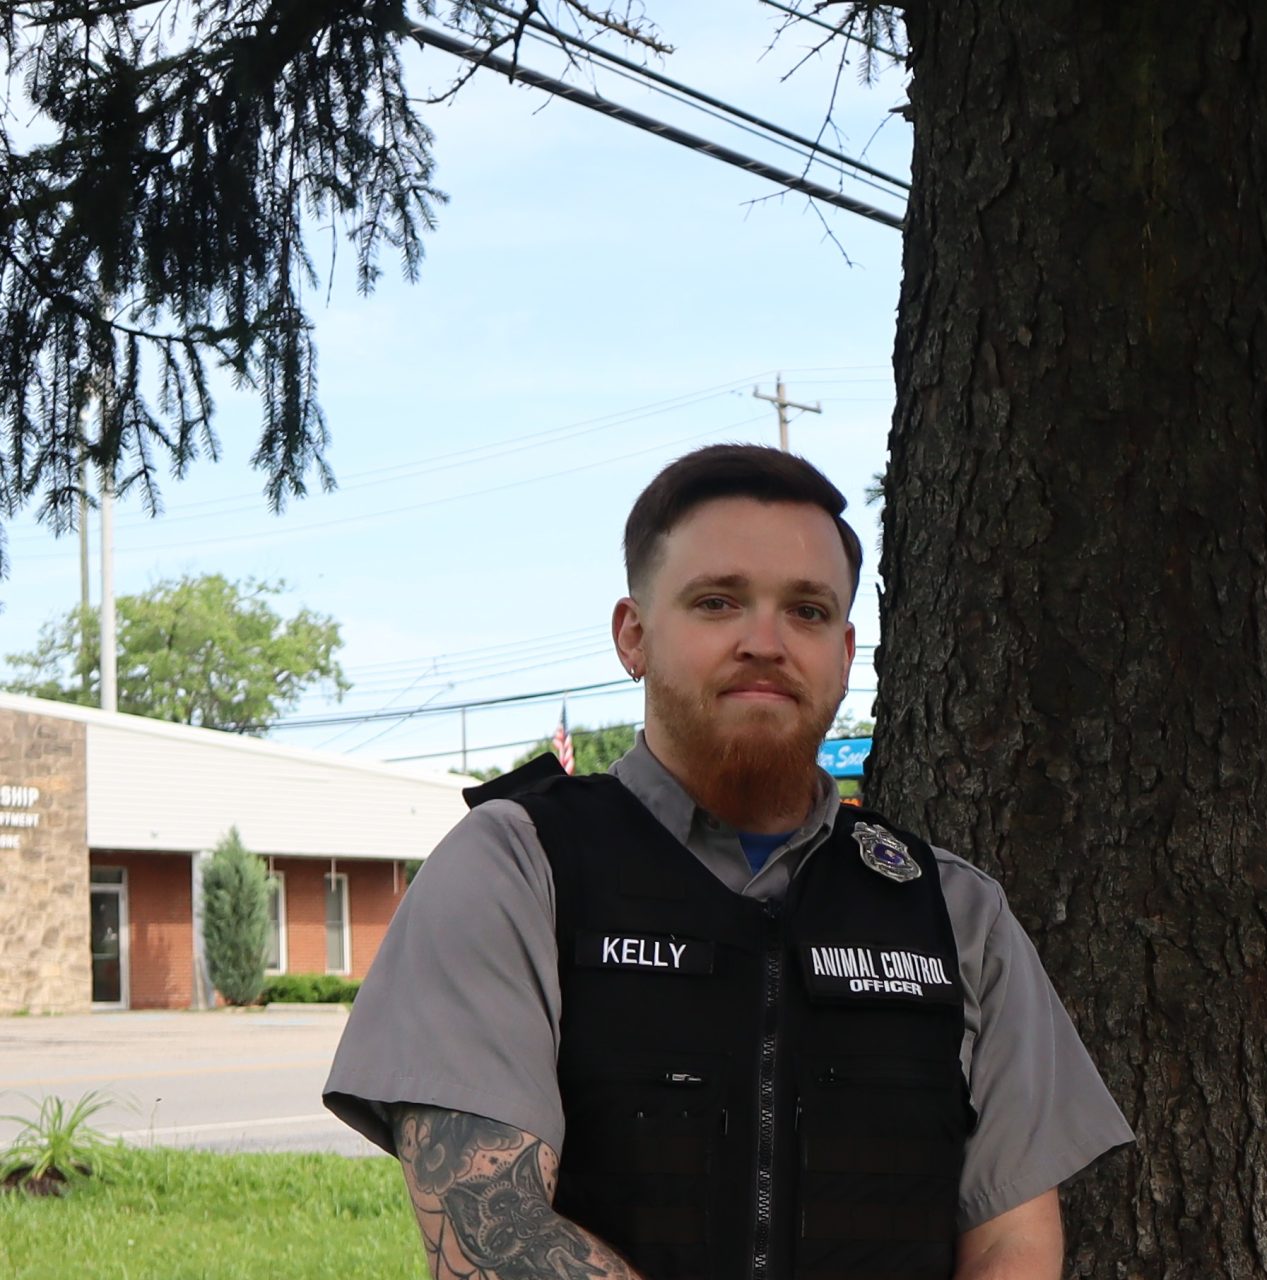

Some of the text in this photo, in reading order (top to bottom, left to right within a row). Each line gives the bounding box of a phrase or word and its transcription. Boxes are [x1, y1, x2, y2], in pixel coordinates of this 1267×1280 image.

[602, 936, 686, 969] KELLY
[811, 947, 952, 985] ANIMAL CONTROL
[849, 979, 923, 996] OFFICER
